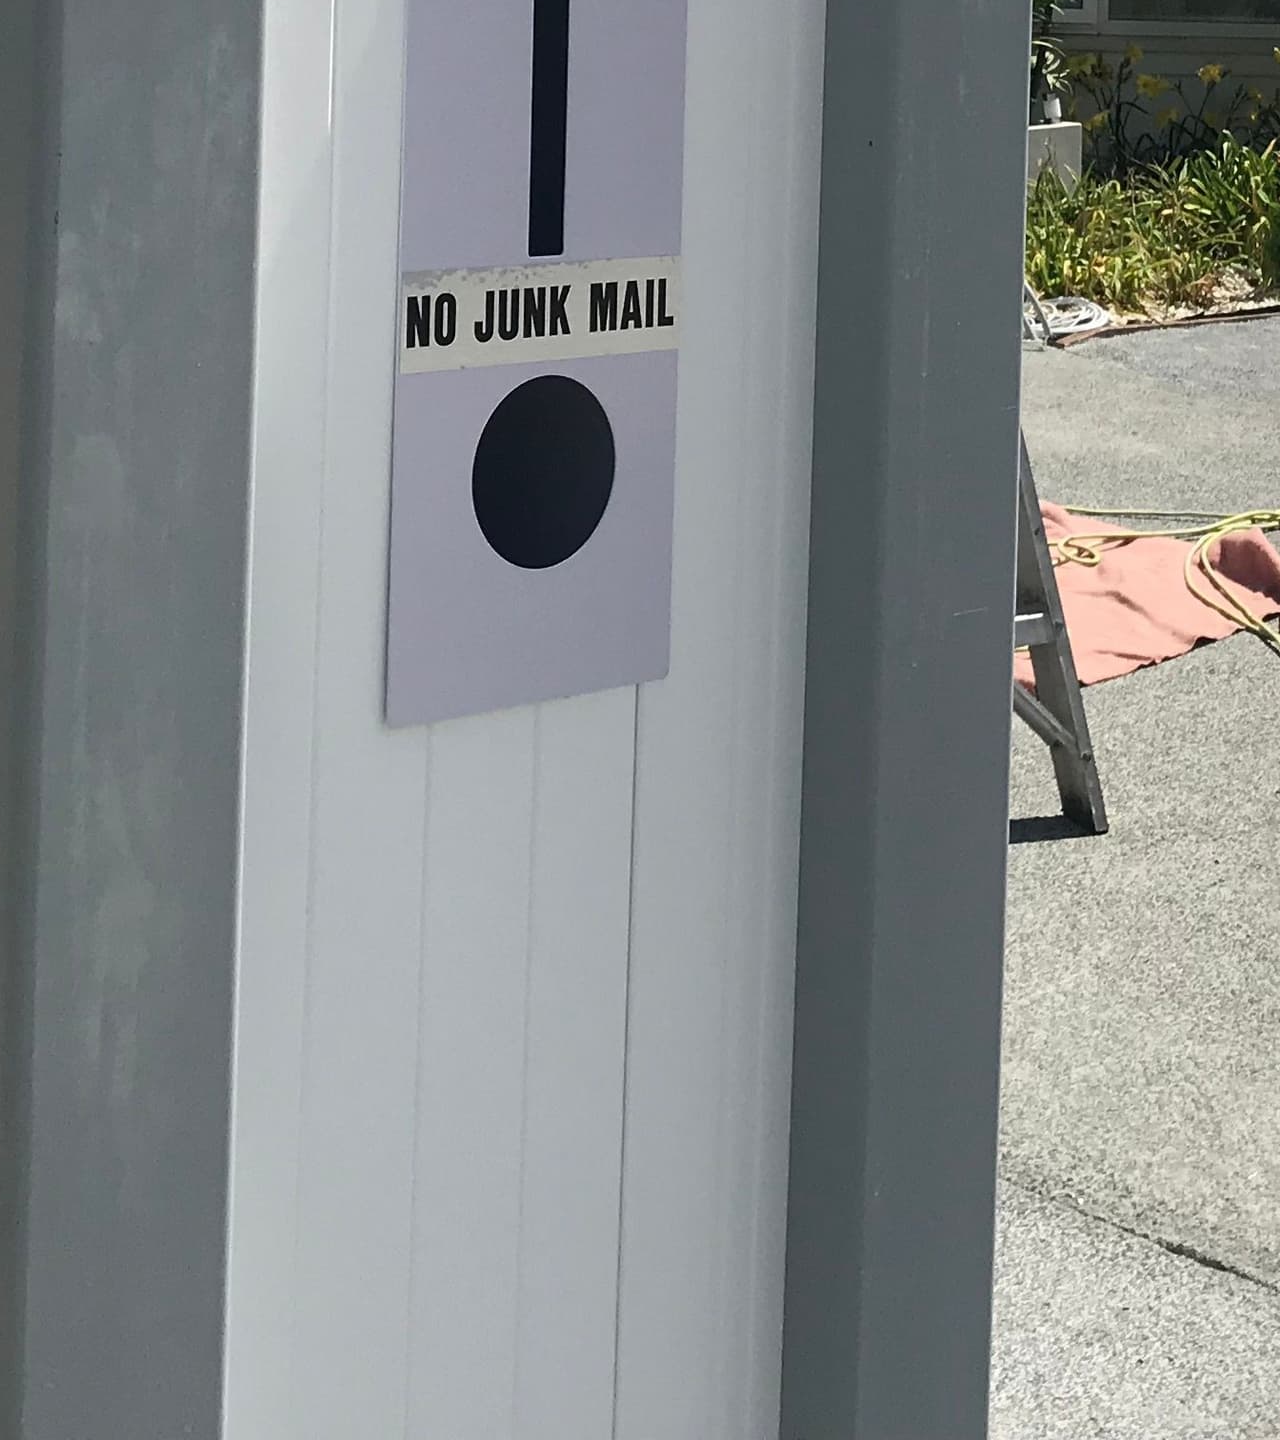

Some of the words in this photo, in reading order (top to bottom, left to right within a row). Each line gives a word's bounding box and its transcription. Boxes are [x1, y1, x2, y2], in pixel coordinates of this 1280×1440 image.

[406, 292, 457, 349] NO
[474, 284, 571, 343] JUNK
[589, 278, 674, 333] MAIL
